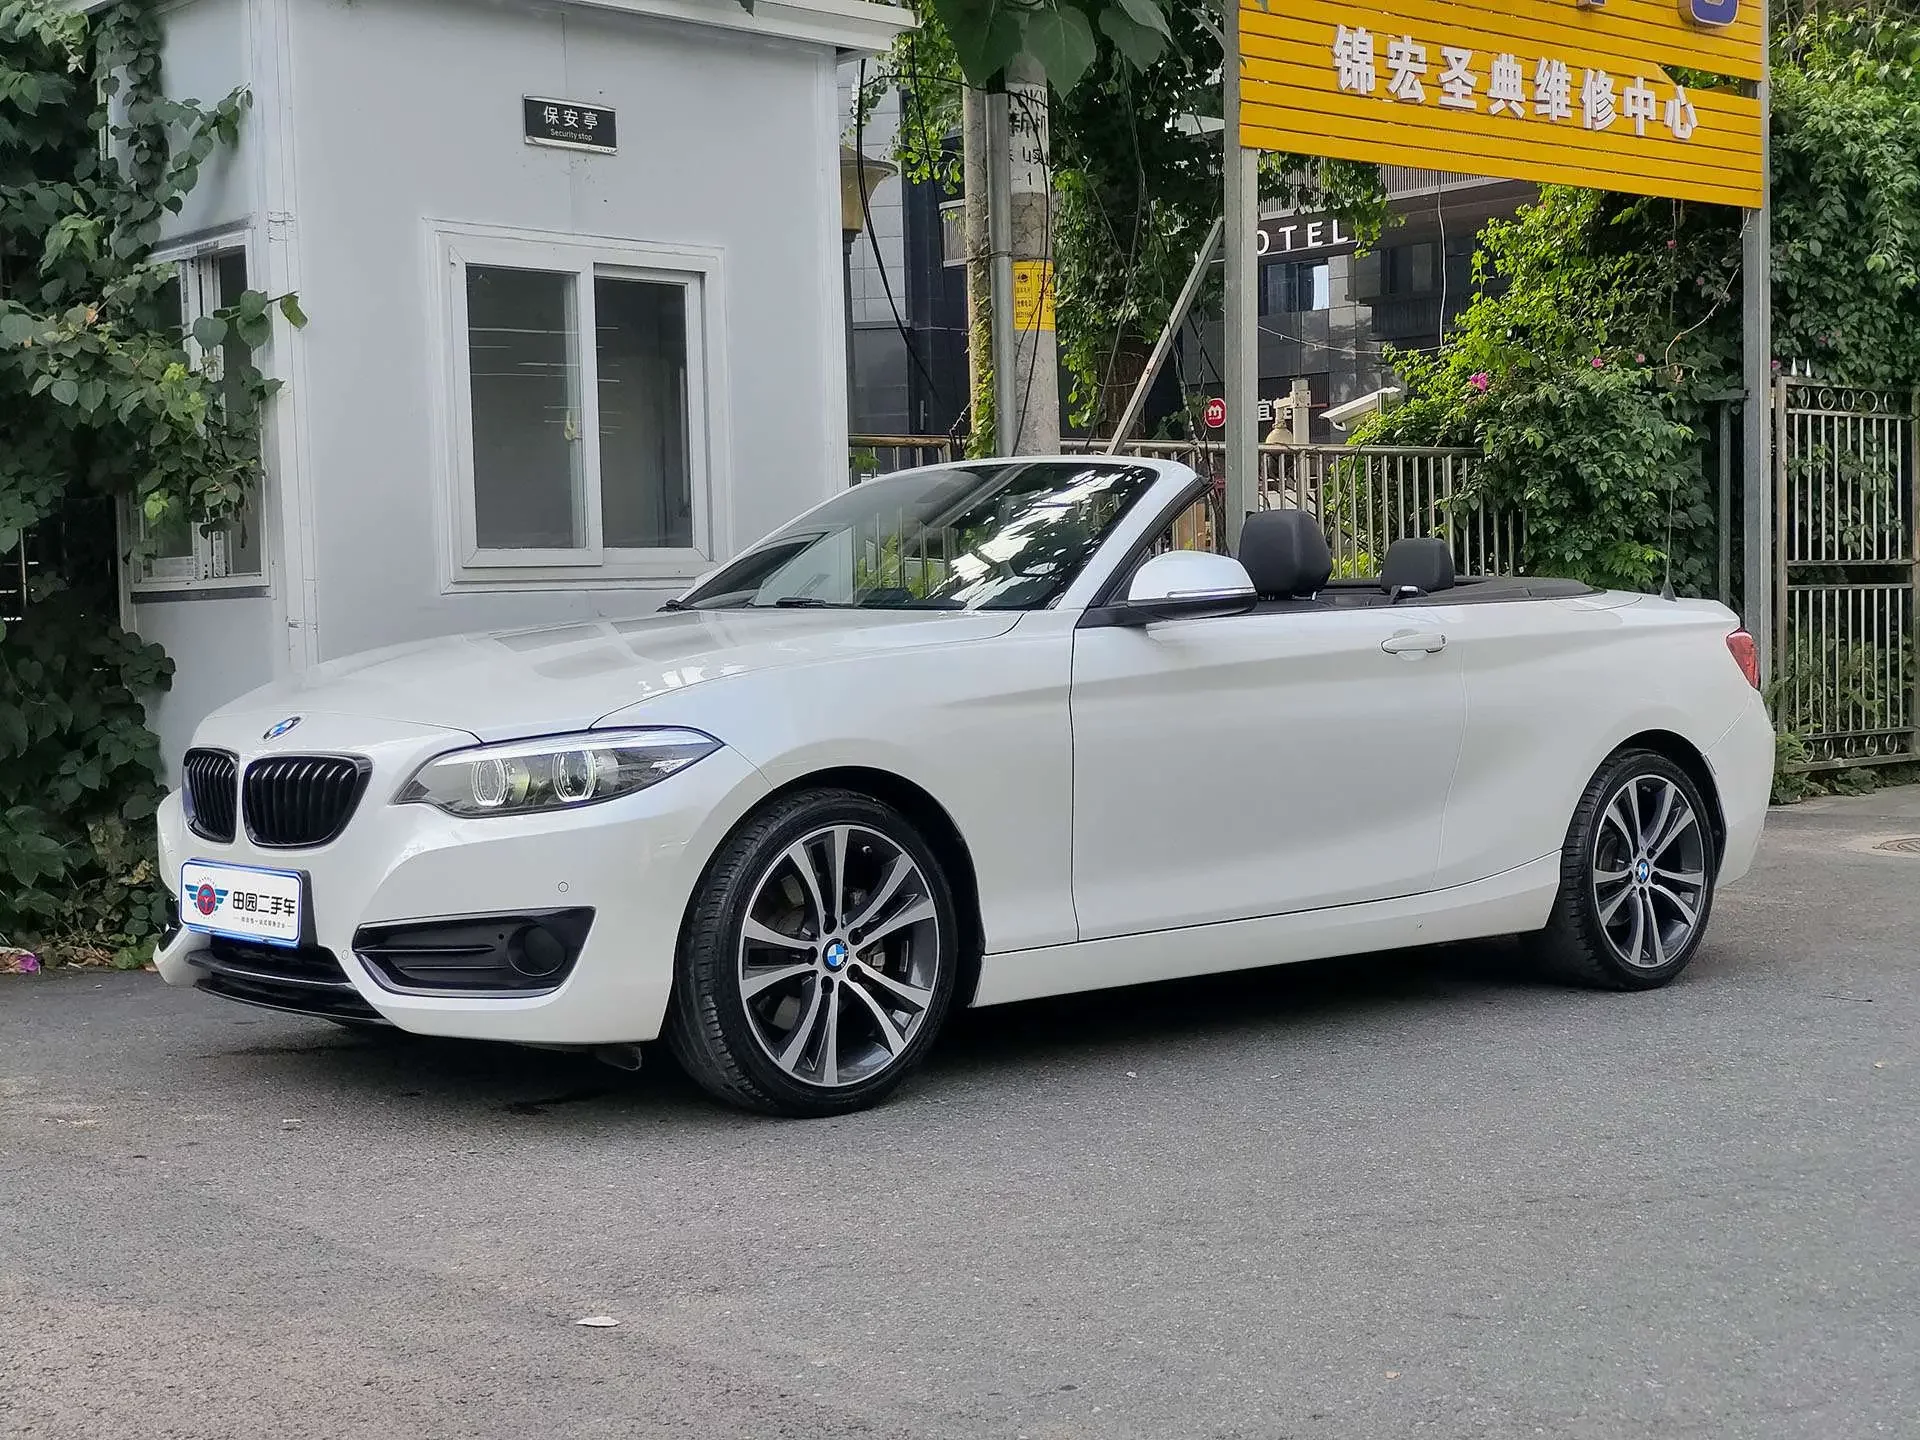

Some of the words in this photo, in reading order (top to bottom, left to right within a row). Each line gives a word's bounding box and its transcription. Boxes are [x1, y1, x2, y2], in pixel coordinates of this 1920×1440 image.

[1332, 23, 1699, 139] 锦宏圣典维修中心
[543, 105, 598, 130] 保安亭
[550, 128, 577, 140] Security
[578, 133, 593, 141] stop
[232, 891, 296, 917] 田园二手车
